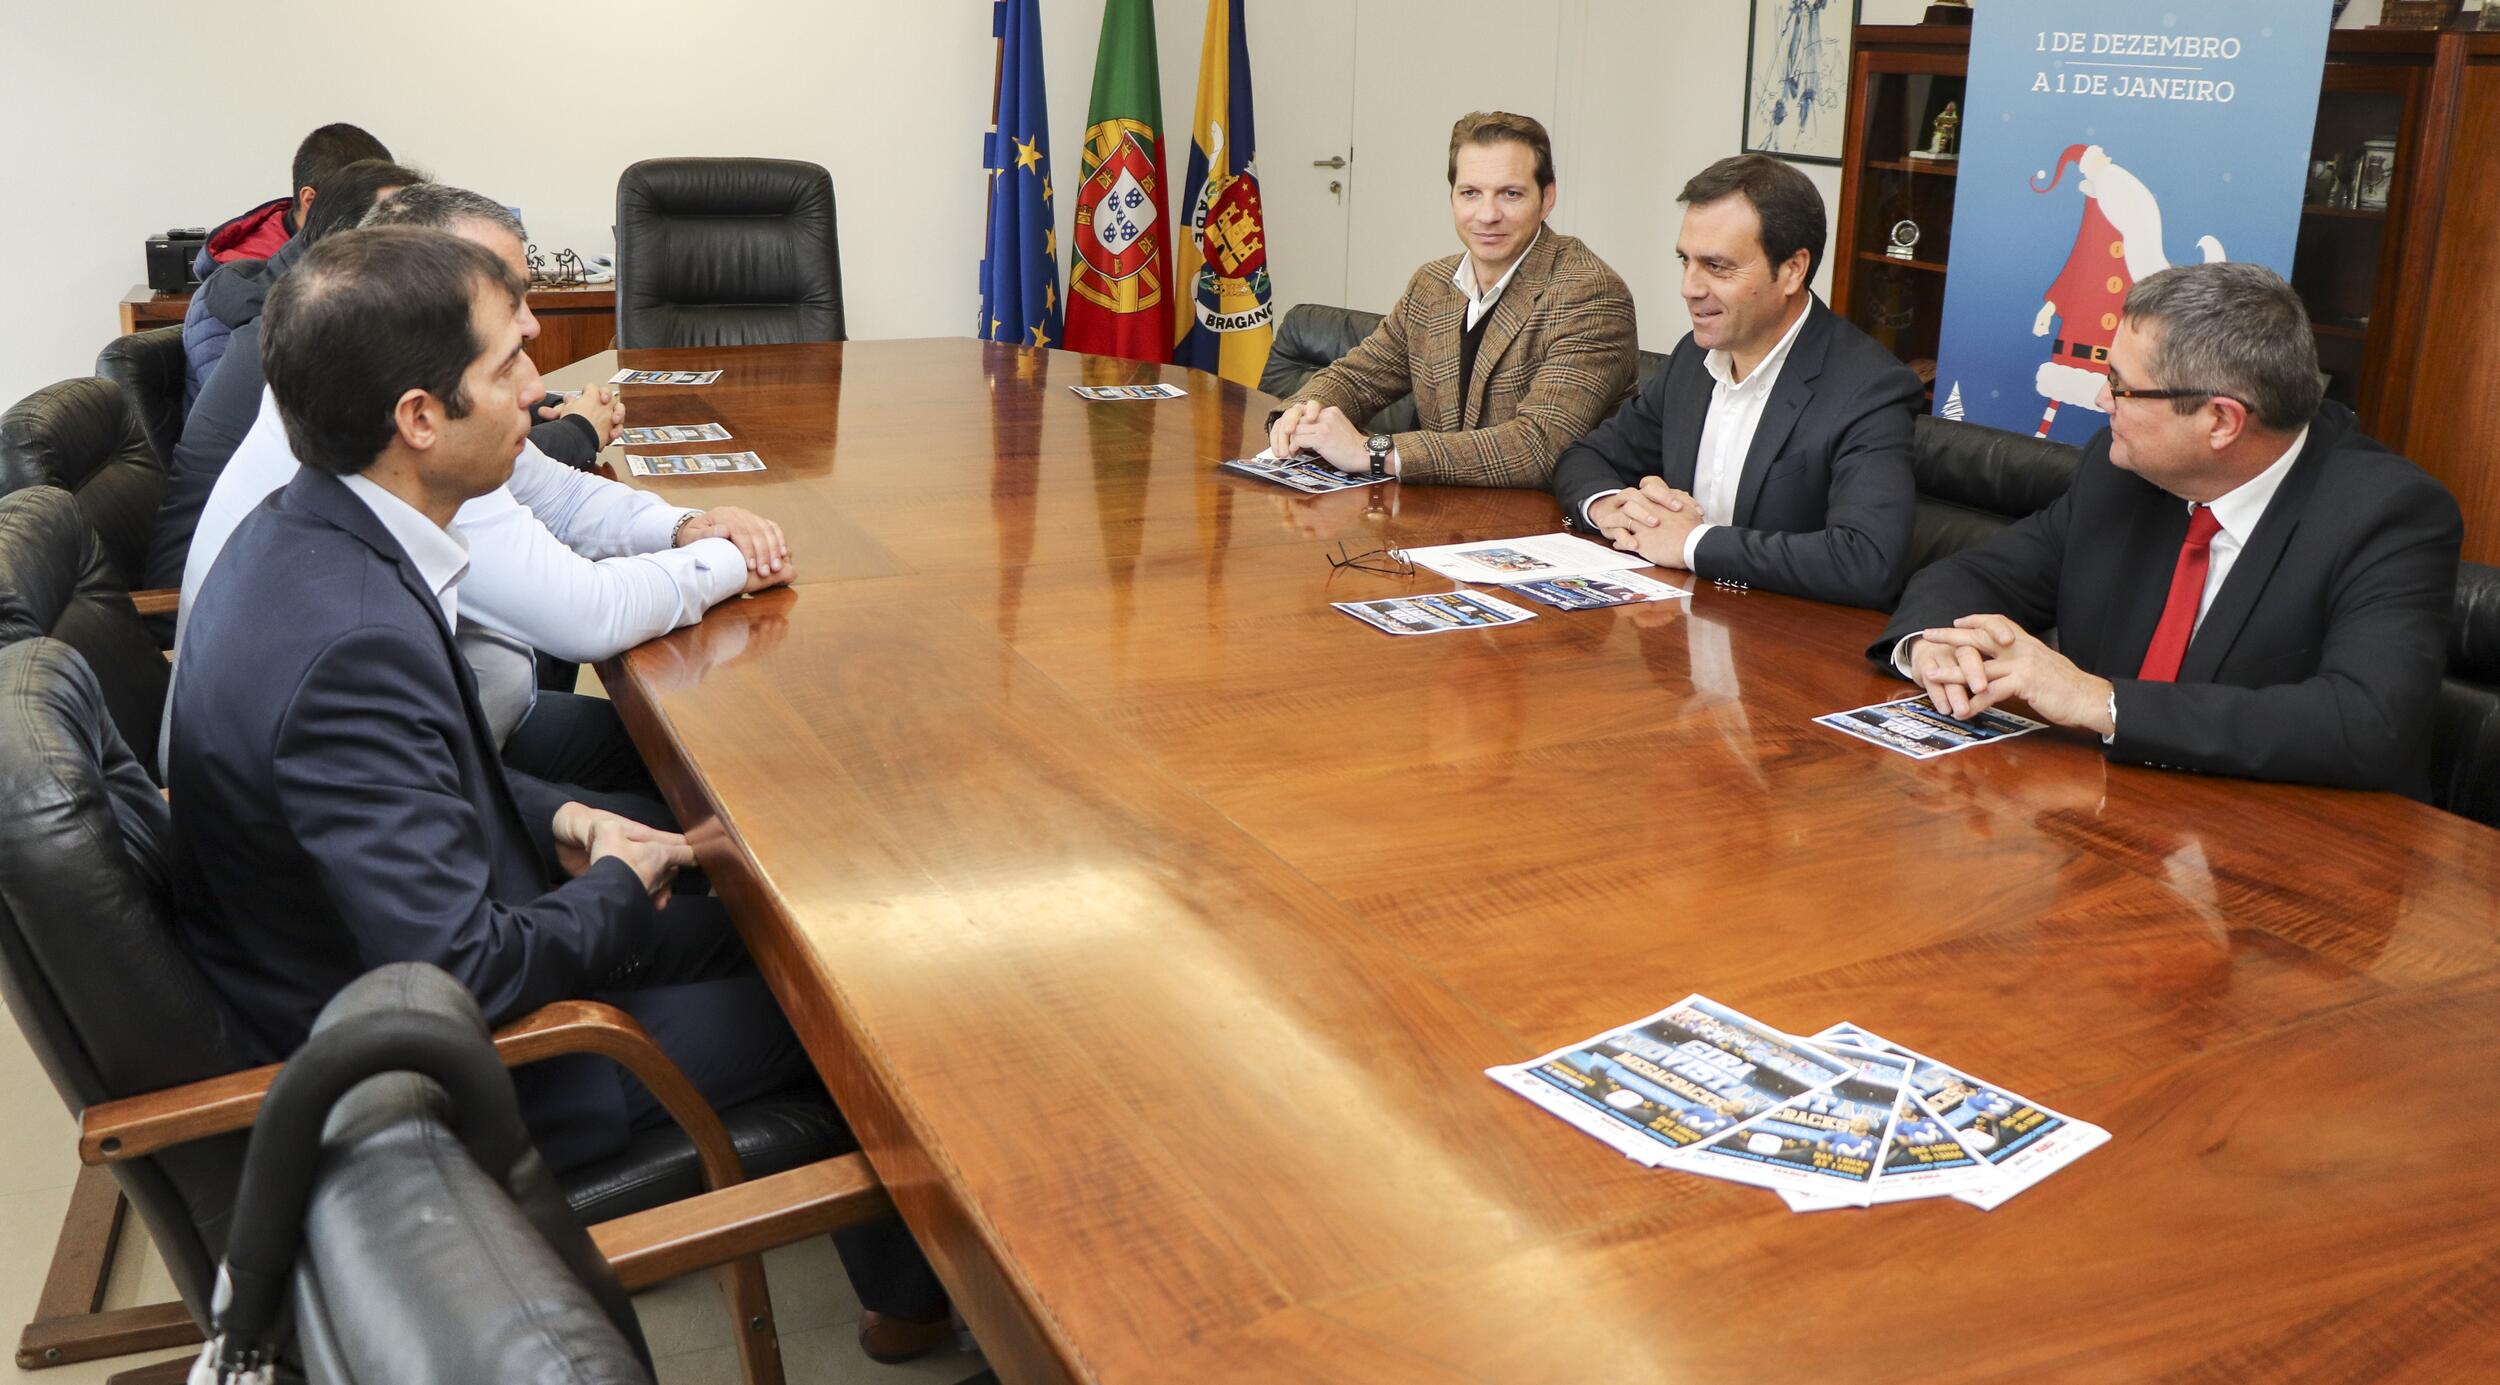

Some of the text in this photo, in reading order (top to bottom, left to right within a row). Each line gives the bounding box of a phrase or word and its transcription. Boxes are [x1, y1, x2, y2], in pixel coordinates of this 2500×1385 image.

[2036, 31, 2241, 60] 1 DE DEZEMBRO
[2031, 71, 2236, 103] A 1 DE JANEIRO
[1677, 1039, 1758, 1080] GIRA
